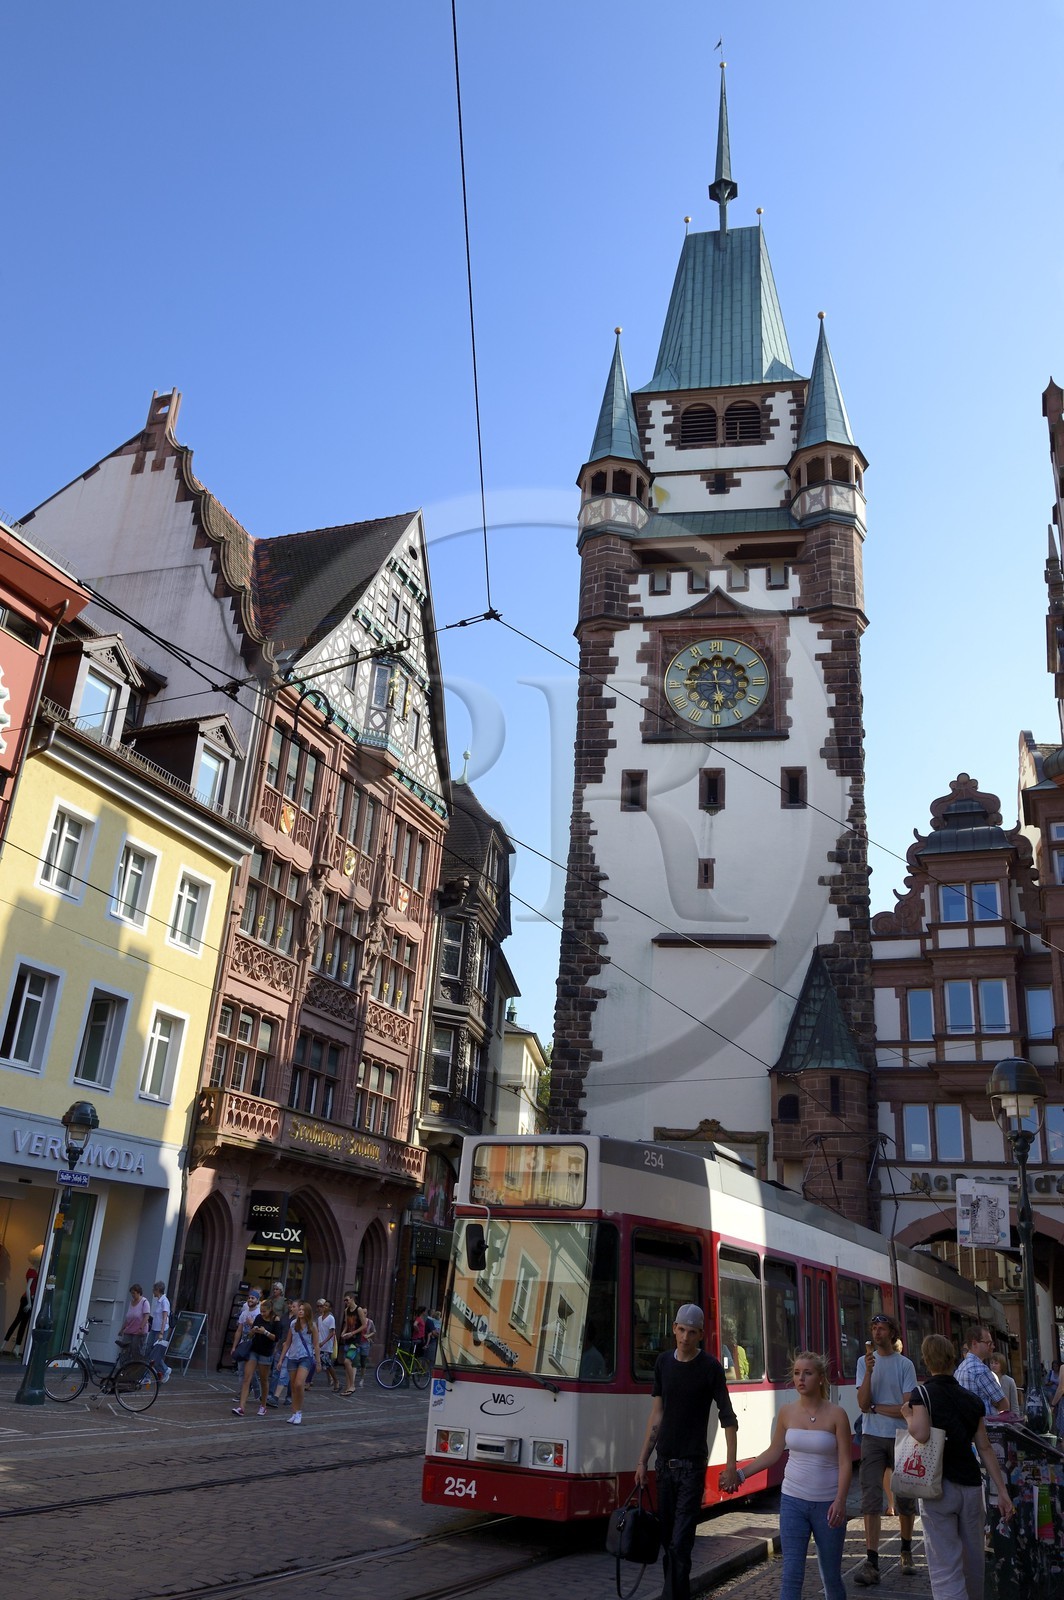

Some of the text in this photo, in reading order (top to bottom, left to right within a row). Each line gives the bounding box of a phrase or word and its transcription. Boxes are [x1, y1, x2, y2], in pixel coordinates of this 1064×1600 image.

[80, 1143, 145, 1174] MODA
[644, 1150, 664, 1168] 254
[911, 1172, 1064, 1194] McDald's
[262, 1228, 301, 1242] GEOX
[492, 1393, 514, 1405] VAG
[444, 1477, 477, 1498] 254
